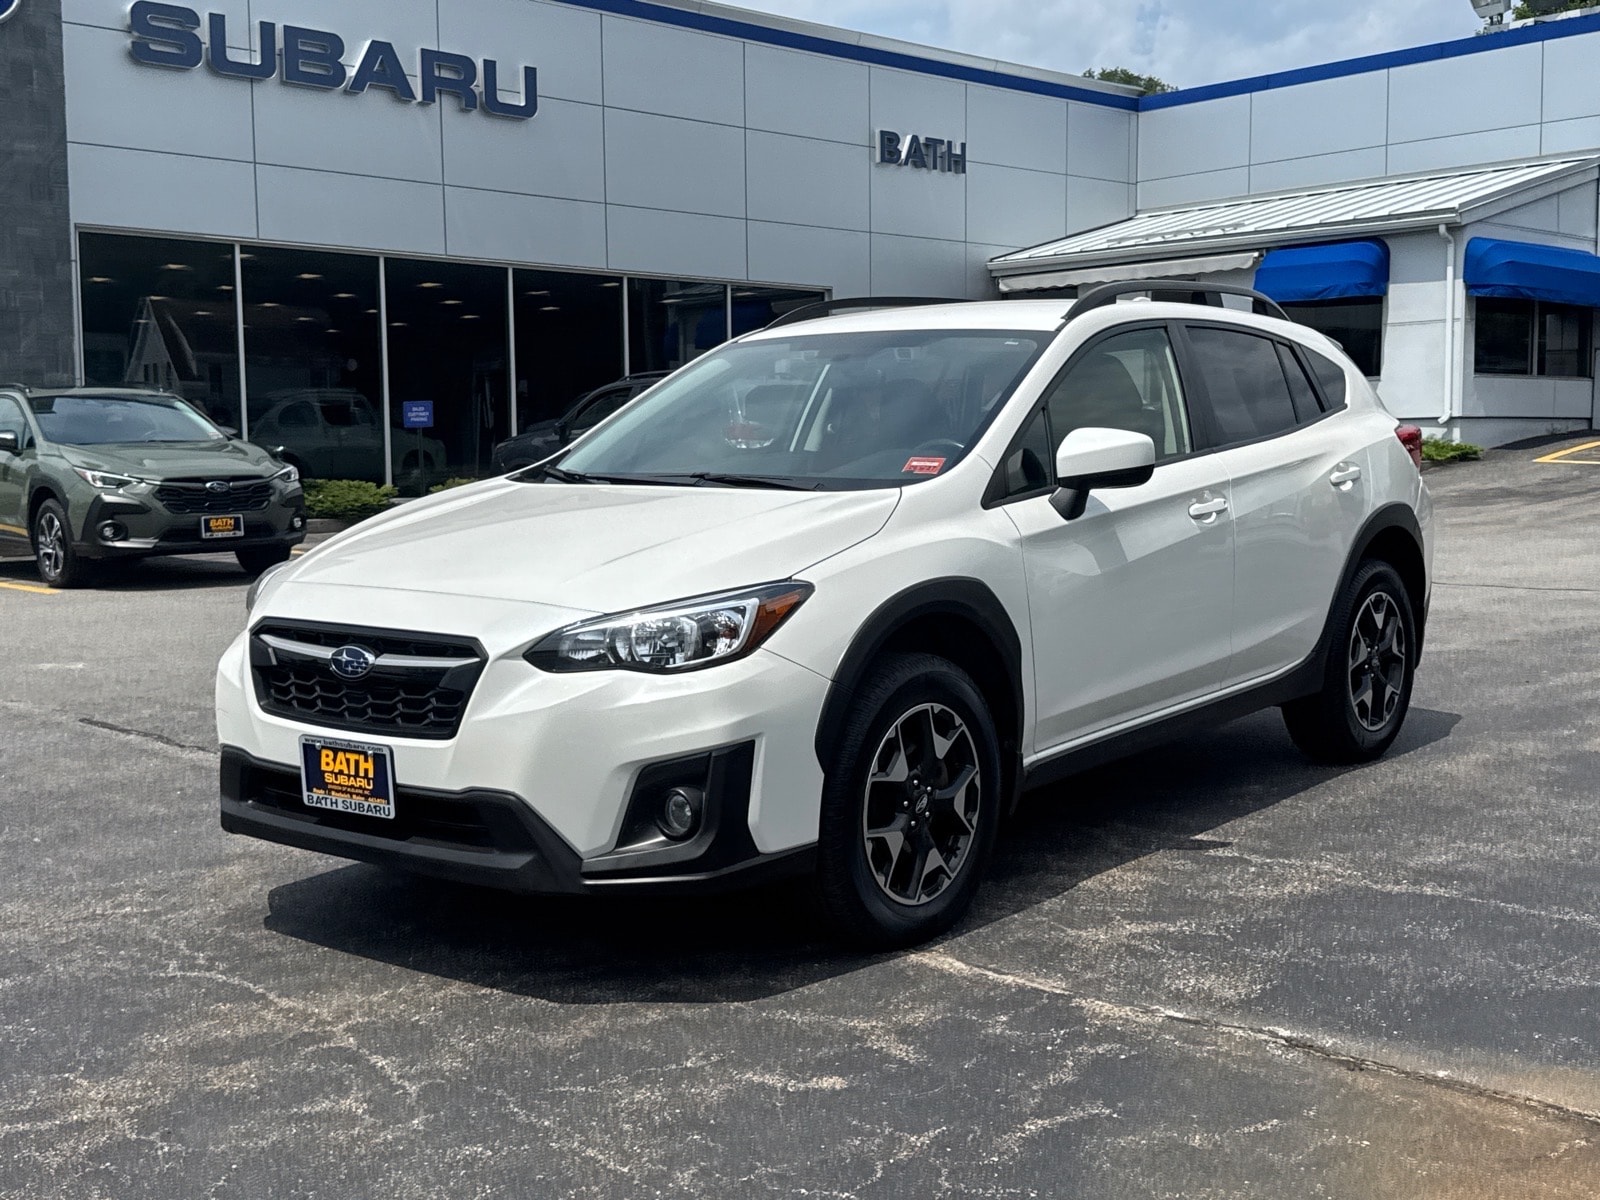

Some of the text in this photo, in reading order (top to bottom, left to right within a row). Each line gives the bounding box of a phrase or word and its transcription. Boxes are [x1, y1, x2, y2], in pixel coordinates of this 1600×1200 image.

[129, 0, 538, 119] SUBARU
[876, 130, 966, 174] BATH
[209, 518, 235, 527] BATH
[321, 748, 374, 778] BATH
[324, 773, 373, 789] SUBARU
[306, 794, 339, 808] BATH
[341, 799, 391, 817] SUBARU
